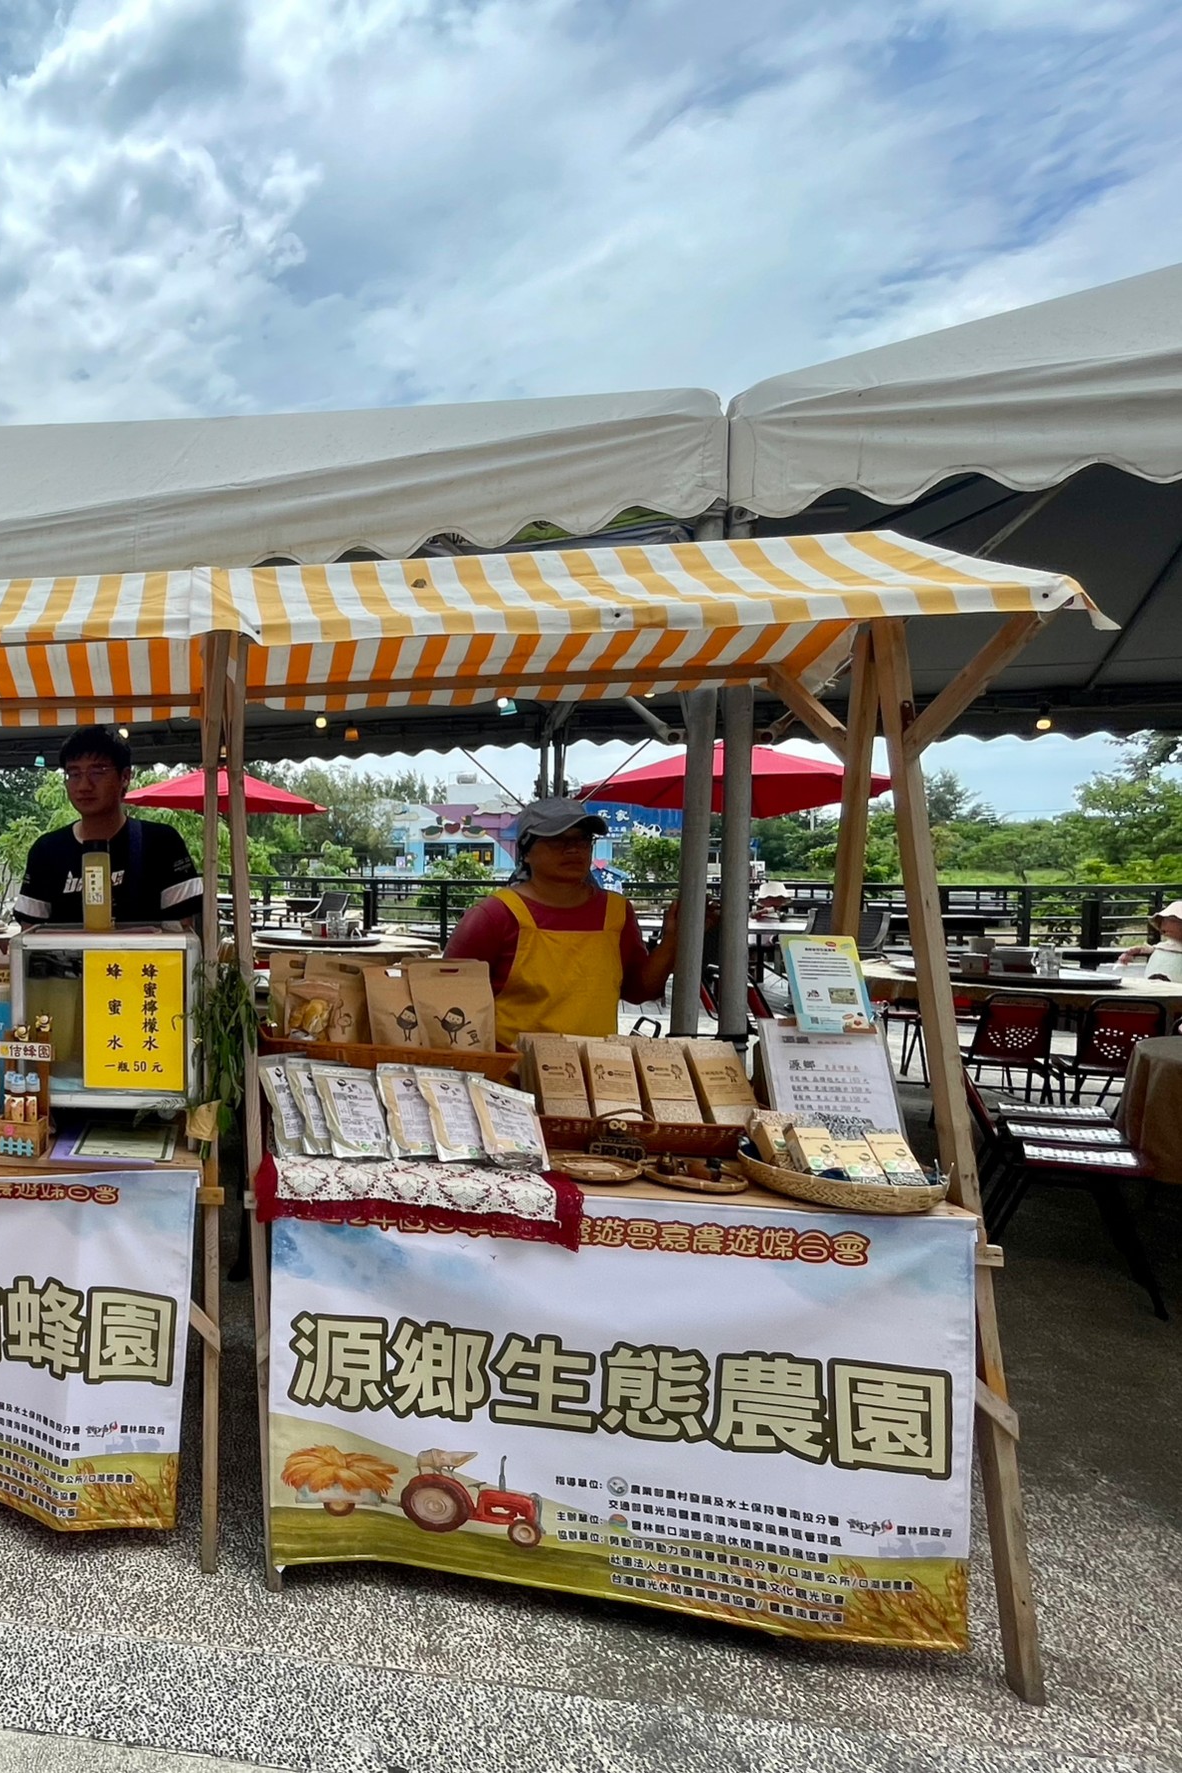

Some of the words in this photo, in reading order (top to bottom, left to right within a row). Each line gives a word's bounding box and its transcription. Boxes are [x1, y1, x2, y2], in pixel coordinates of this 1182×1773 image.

[105, 963, 124, 1051] 蜂蜜水
[141, 963, 159, 1051] 蜂蜜檸檬水
[104, 1061, 130, 1073] 一瓶
[133, 1061, 147, 1072] 50
[152, 1061, 163, 1073] 元
[288, 1309, 953, 1480] 源鄉生態農園
